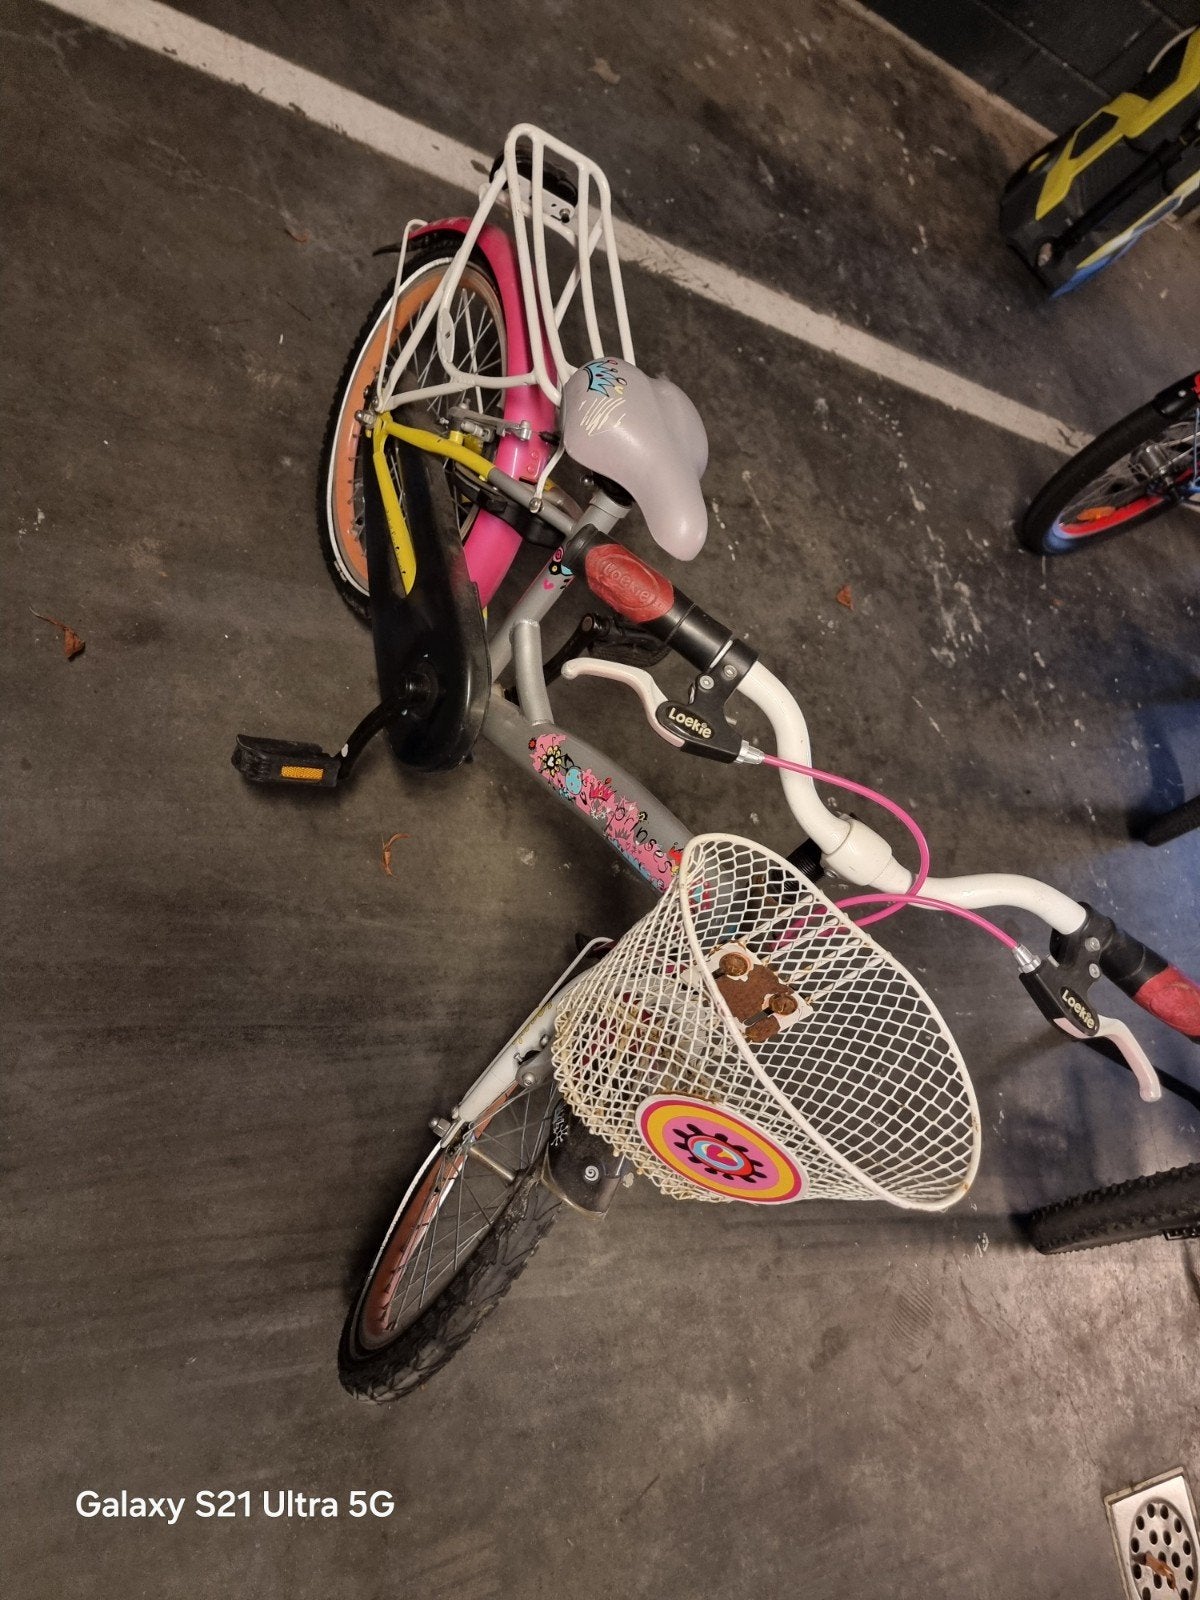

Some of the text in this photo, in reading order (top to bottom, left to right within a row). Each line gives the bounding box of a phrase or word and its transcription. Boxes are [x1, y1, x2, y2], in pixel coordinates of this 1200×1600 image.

[668, 707, 713, 739] Loekie
[604, 804, 673, 874] prinses
[1061, 989, 1095, 1029] Loekie
